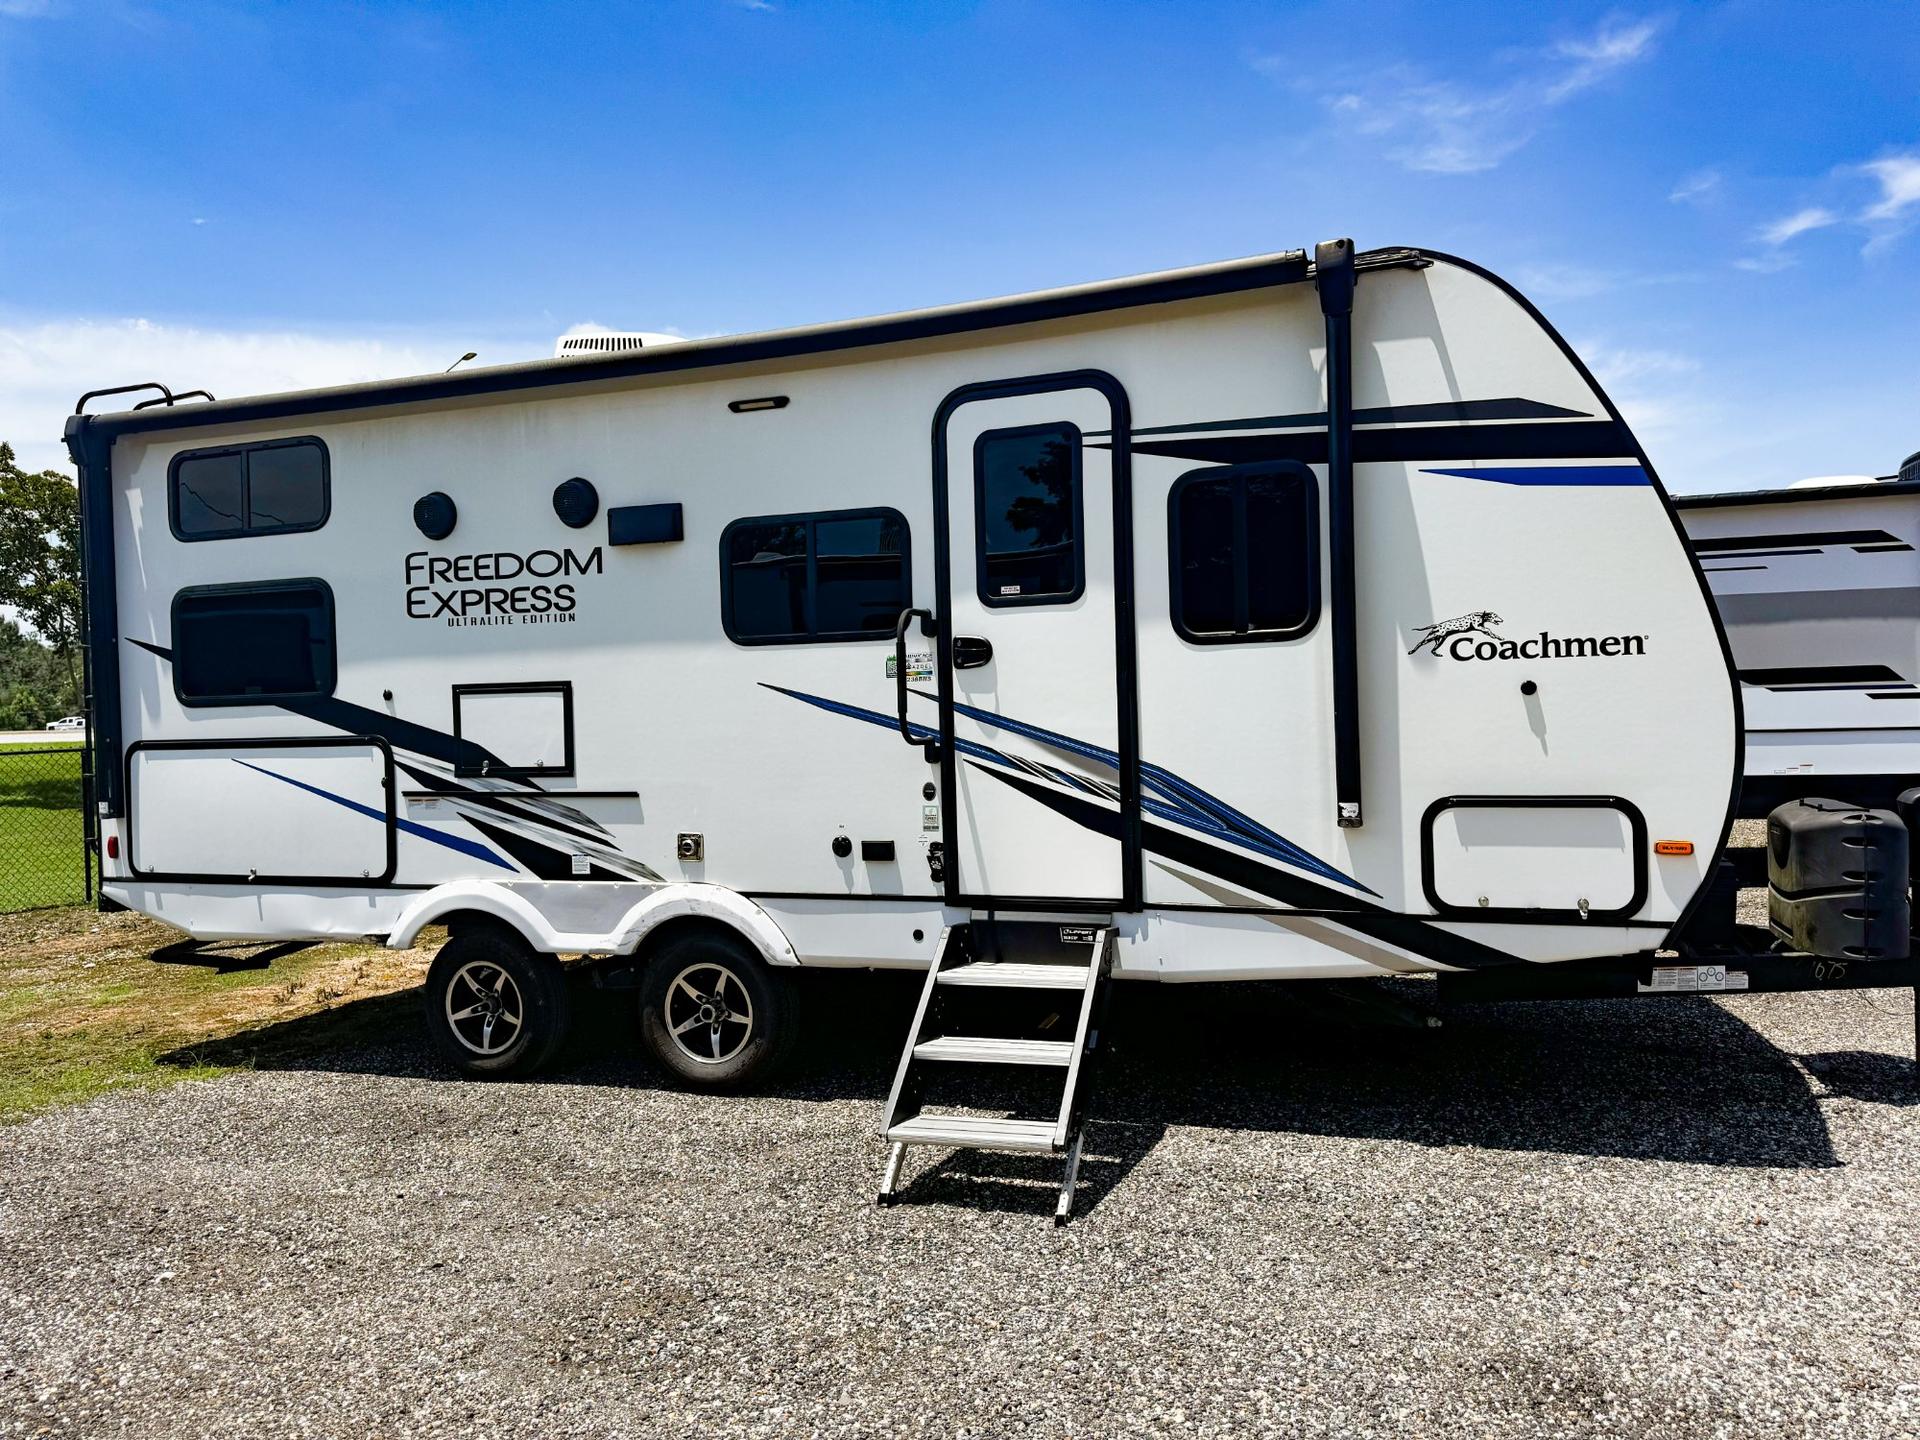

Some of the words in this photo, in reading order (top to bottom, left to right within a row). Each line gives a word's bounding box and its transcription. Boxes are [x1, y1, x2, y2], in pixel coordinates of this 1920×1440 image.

[405, 547, 603, 585] FREEDOM
[406, 584, 577, 619] EXPRESS
[448, 615, 514, 627] ULTRALITE
[522, 613, 576, 624] EDITION
[1450, 631, 1646, 662] Coachmen
